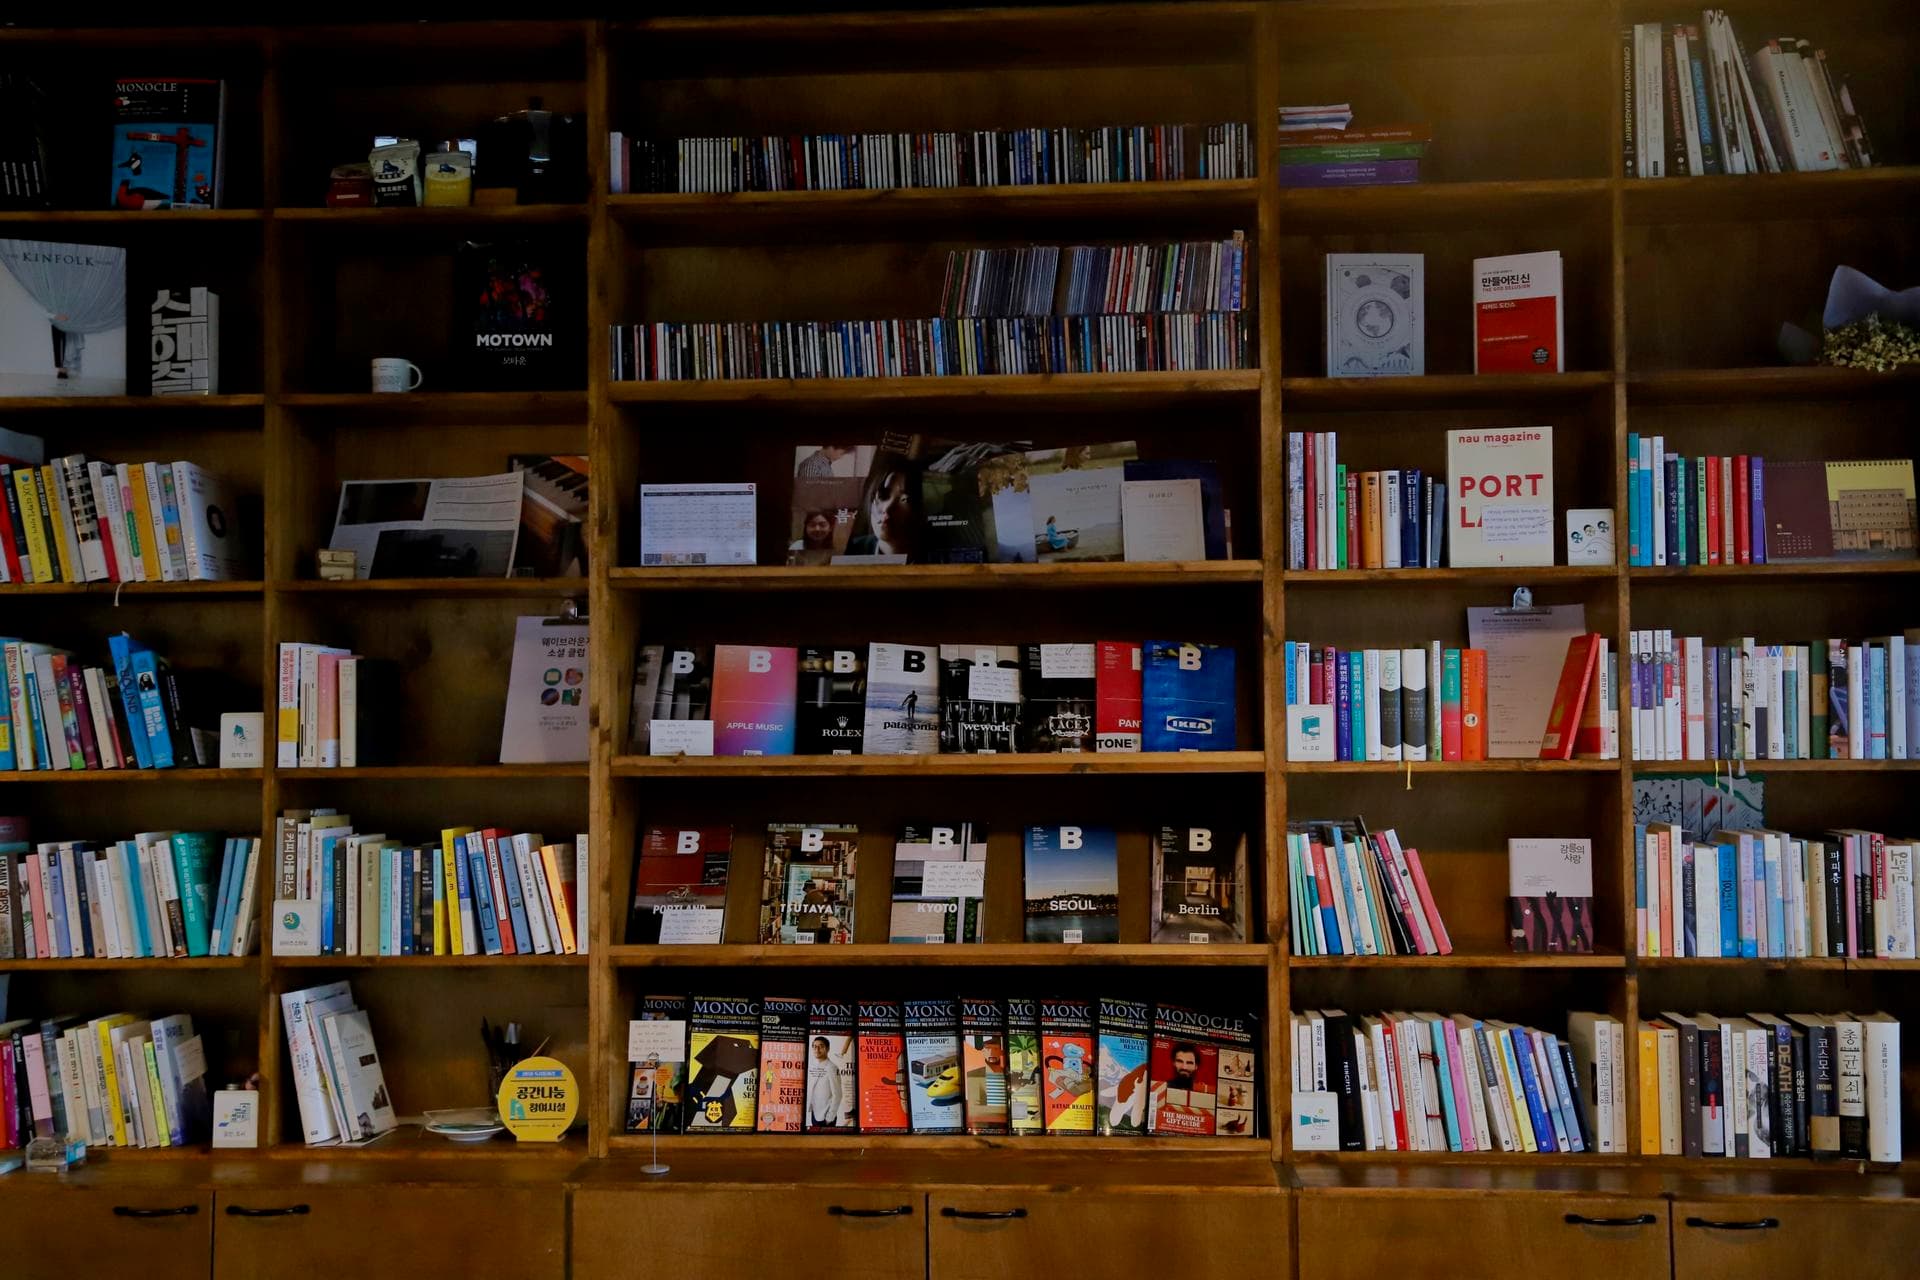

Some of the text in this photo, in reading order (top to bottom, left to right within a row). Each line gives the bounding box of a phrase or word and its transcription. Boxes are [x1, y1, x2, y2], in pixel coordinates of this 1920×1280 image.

[115, 82, 178, 93] MONOCLE
[1624, 91, 1633, 142] MANAGEMENT
[22, 251, 95, 266] KINFOLK
[1481, 273, 1531, 287] 만들어진 신
[475, 333, 544, 345] MOTOWN
[1458, 431, 1541, 444] nau magazine
[1460, 474, 1544, 498] PORT
[547, 648, 586, 658] 소셜 클럽
[1179, 646, 1202, 671] B
[672, 651, 695, 674] B
[749, 650, 772, 673] B
[833, 650, 857, 673] B
[903, 650, 925, 672] B
[726, 722, 783, 732] APPLE MUSIC
[883, 720, 938, 731] patagonia
[963, 721, 1010, 732] wework
[1057, 718, 1082, 730] ACE
[1172, 720, 1208, 731] IKEA
[822, 728, 863, 738] ROLEX
[677, 831, 700, 854] B
[800, 828, 824, 853] B
[931, 827, 955, 849] B
[1059, 826, 1083, 850] B
[1189, 828, 1213, 852] B
[780, 903, 833, 914] TSUTAYA
[917, 903, 958, 914] KYOTO
[1049, 899, 1097, 912] SEOUL
[1178, 903, 1221, 916] Berlin
[693, 1001, 760, 1016] MONOC
[810, 1003, 852, 1017] MON
[858, 1005, 900, 1017] MON
[1155, 1007, 1244, 1032] MONOCLE
[865, 1038, 894, 1046] WHERE
[781, 1060, 791, 1069] TO
[1817, 1037, 1831, 1082] 코스모스
[1843, 1029, 1860, 1098] 총 균 쇠
[1777, 1044, 1792, 1094] DEATH
[1343, 1060, 1351, 1095] PRINCIPLES
[779, 1096, 802, 1105] SAFE
[1166, 1118, 1200, 1128] GIFT GUIDE
[1173, 1112, 1205, 1122] MONOCLE
